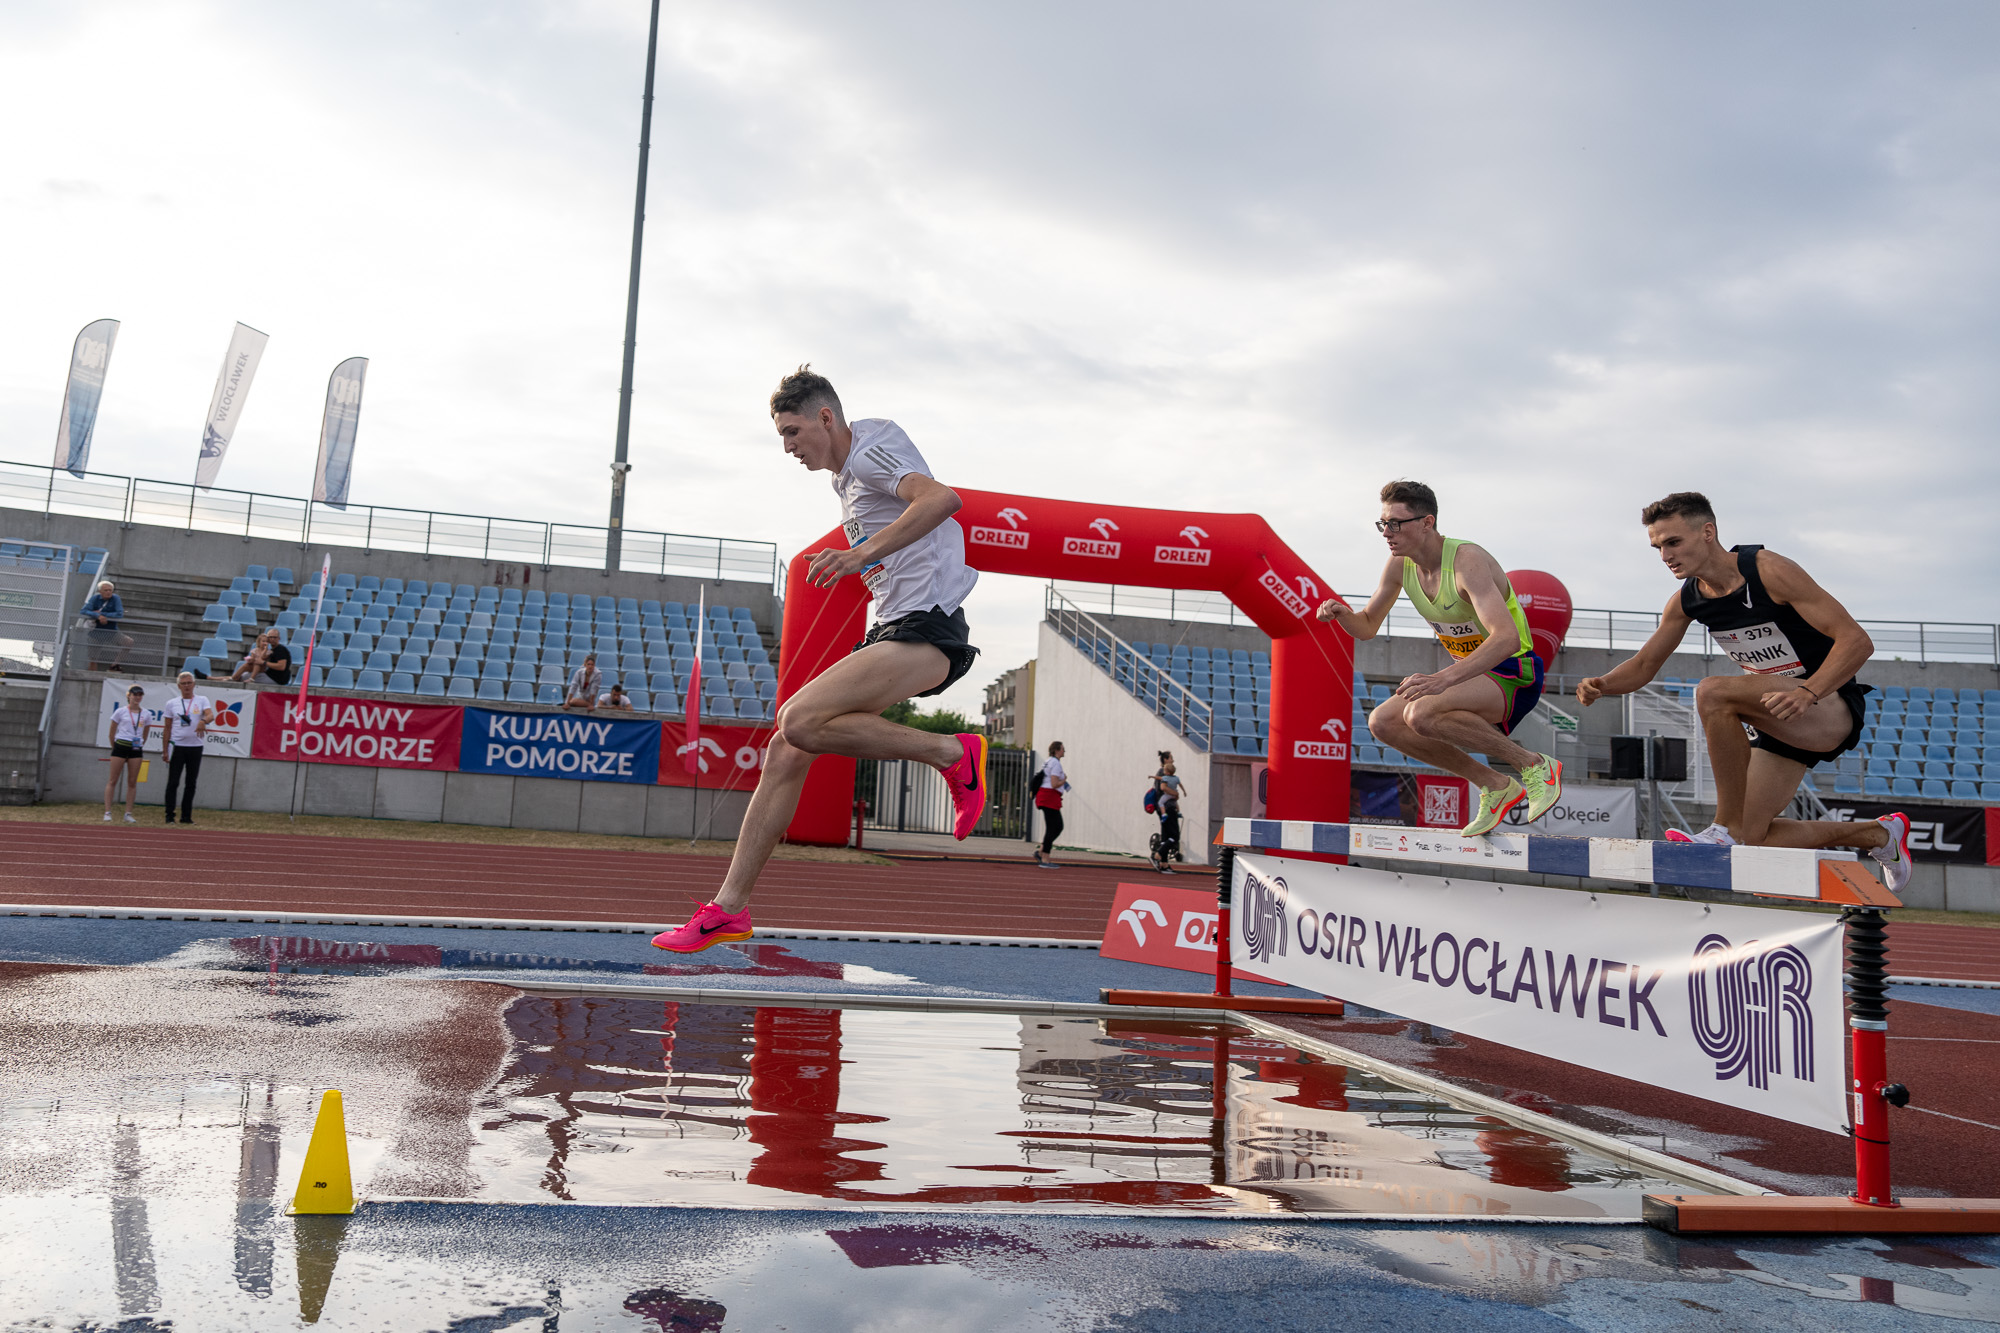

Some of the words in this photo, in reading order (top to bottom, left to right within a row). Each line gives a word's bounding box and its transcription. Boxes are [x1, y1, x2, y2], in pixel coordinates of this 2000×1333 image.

[216, 352, 249, 421] WŁOCŁAWEK
[974, 530, 1025, 546] ORLEN
[1067, 540, 1117, 556] ORLEN
[1158, 549, 1207, 563] ORLEN
[1264, 574, 1306, 615] ORLEN
[1450, 625, 1473, 635] 326
[1745, 627, 1772, 640] 379
[1730, 644, 1788, 663] OCHNIK
[283, 700, 413, 732] KUJAWY
[488, 715, 614, 745] KUJAWY
[207, 735, 239, 745] GROUP
[280, 730, 435, 762] POMORZE
[485, 743, 634, 776] POMORZE
[1298, 744, 1344, 757] ORLEN
[1552, 806, 1610, 824] Okęcie
[1296, 908, 1365, 968] OSIR
[1375, 920, 1668, 1037] WŁOCŁAWEK
